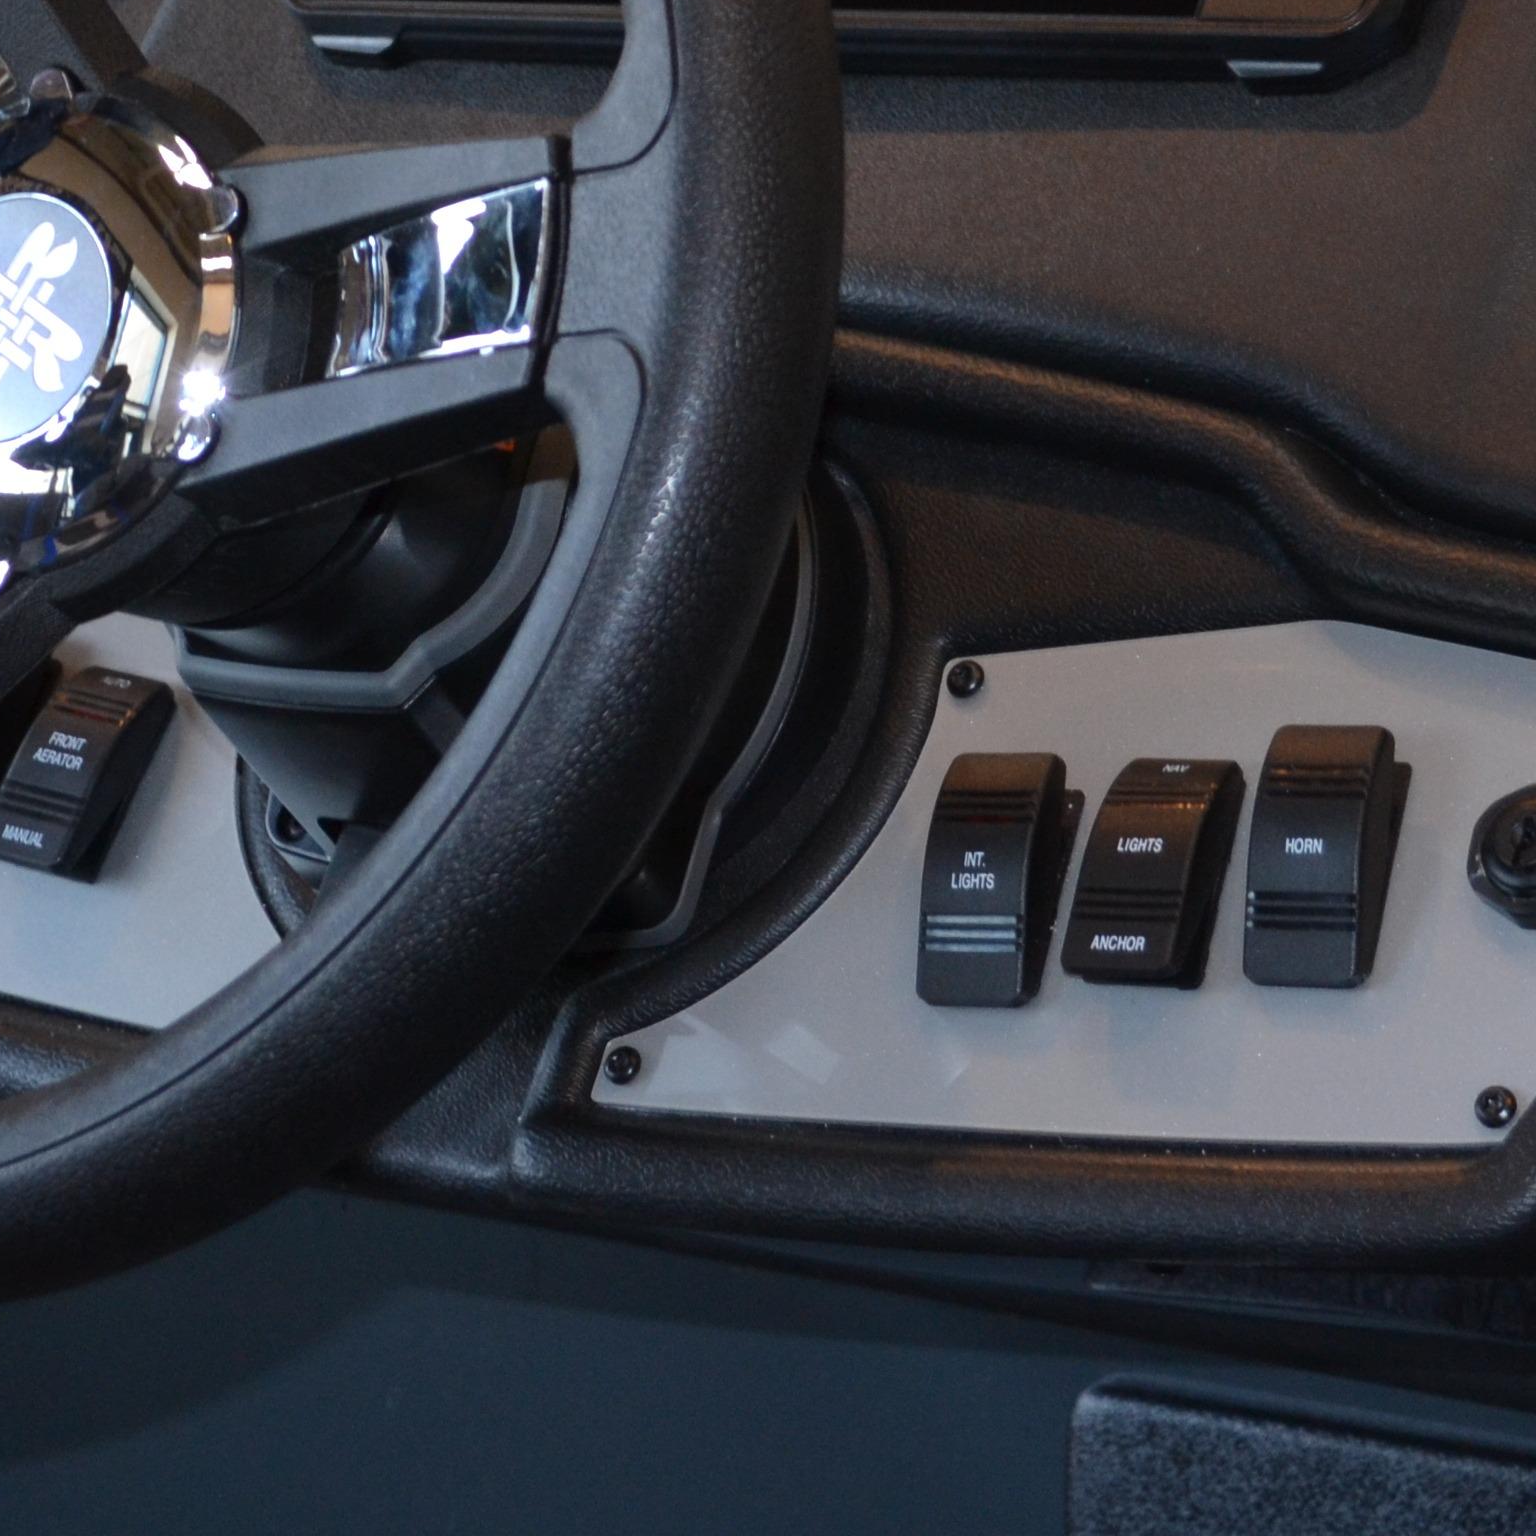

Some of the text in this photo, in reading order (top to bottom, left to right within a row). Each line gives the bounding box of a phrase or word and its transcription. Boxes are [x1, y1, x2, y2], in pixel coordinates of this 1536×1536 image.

[49, 731, 87, 749] FRONT
[33, 747, 84, 770] AERATOR
[1163, 764, 1190, 773] NAV
[2, 823, 44, 848] MANUAL
[1117, 838, 1163, 853] LIGHTS
[1285, 838, 1323, 854] HORN
[964, 852, 986, 867] INT.
[951, 873, 995, 889] LIGHTS
[1090, 935, 1145, 952] ANCHOR
